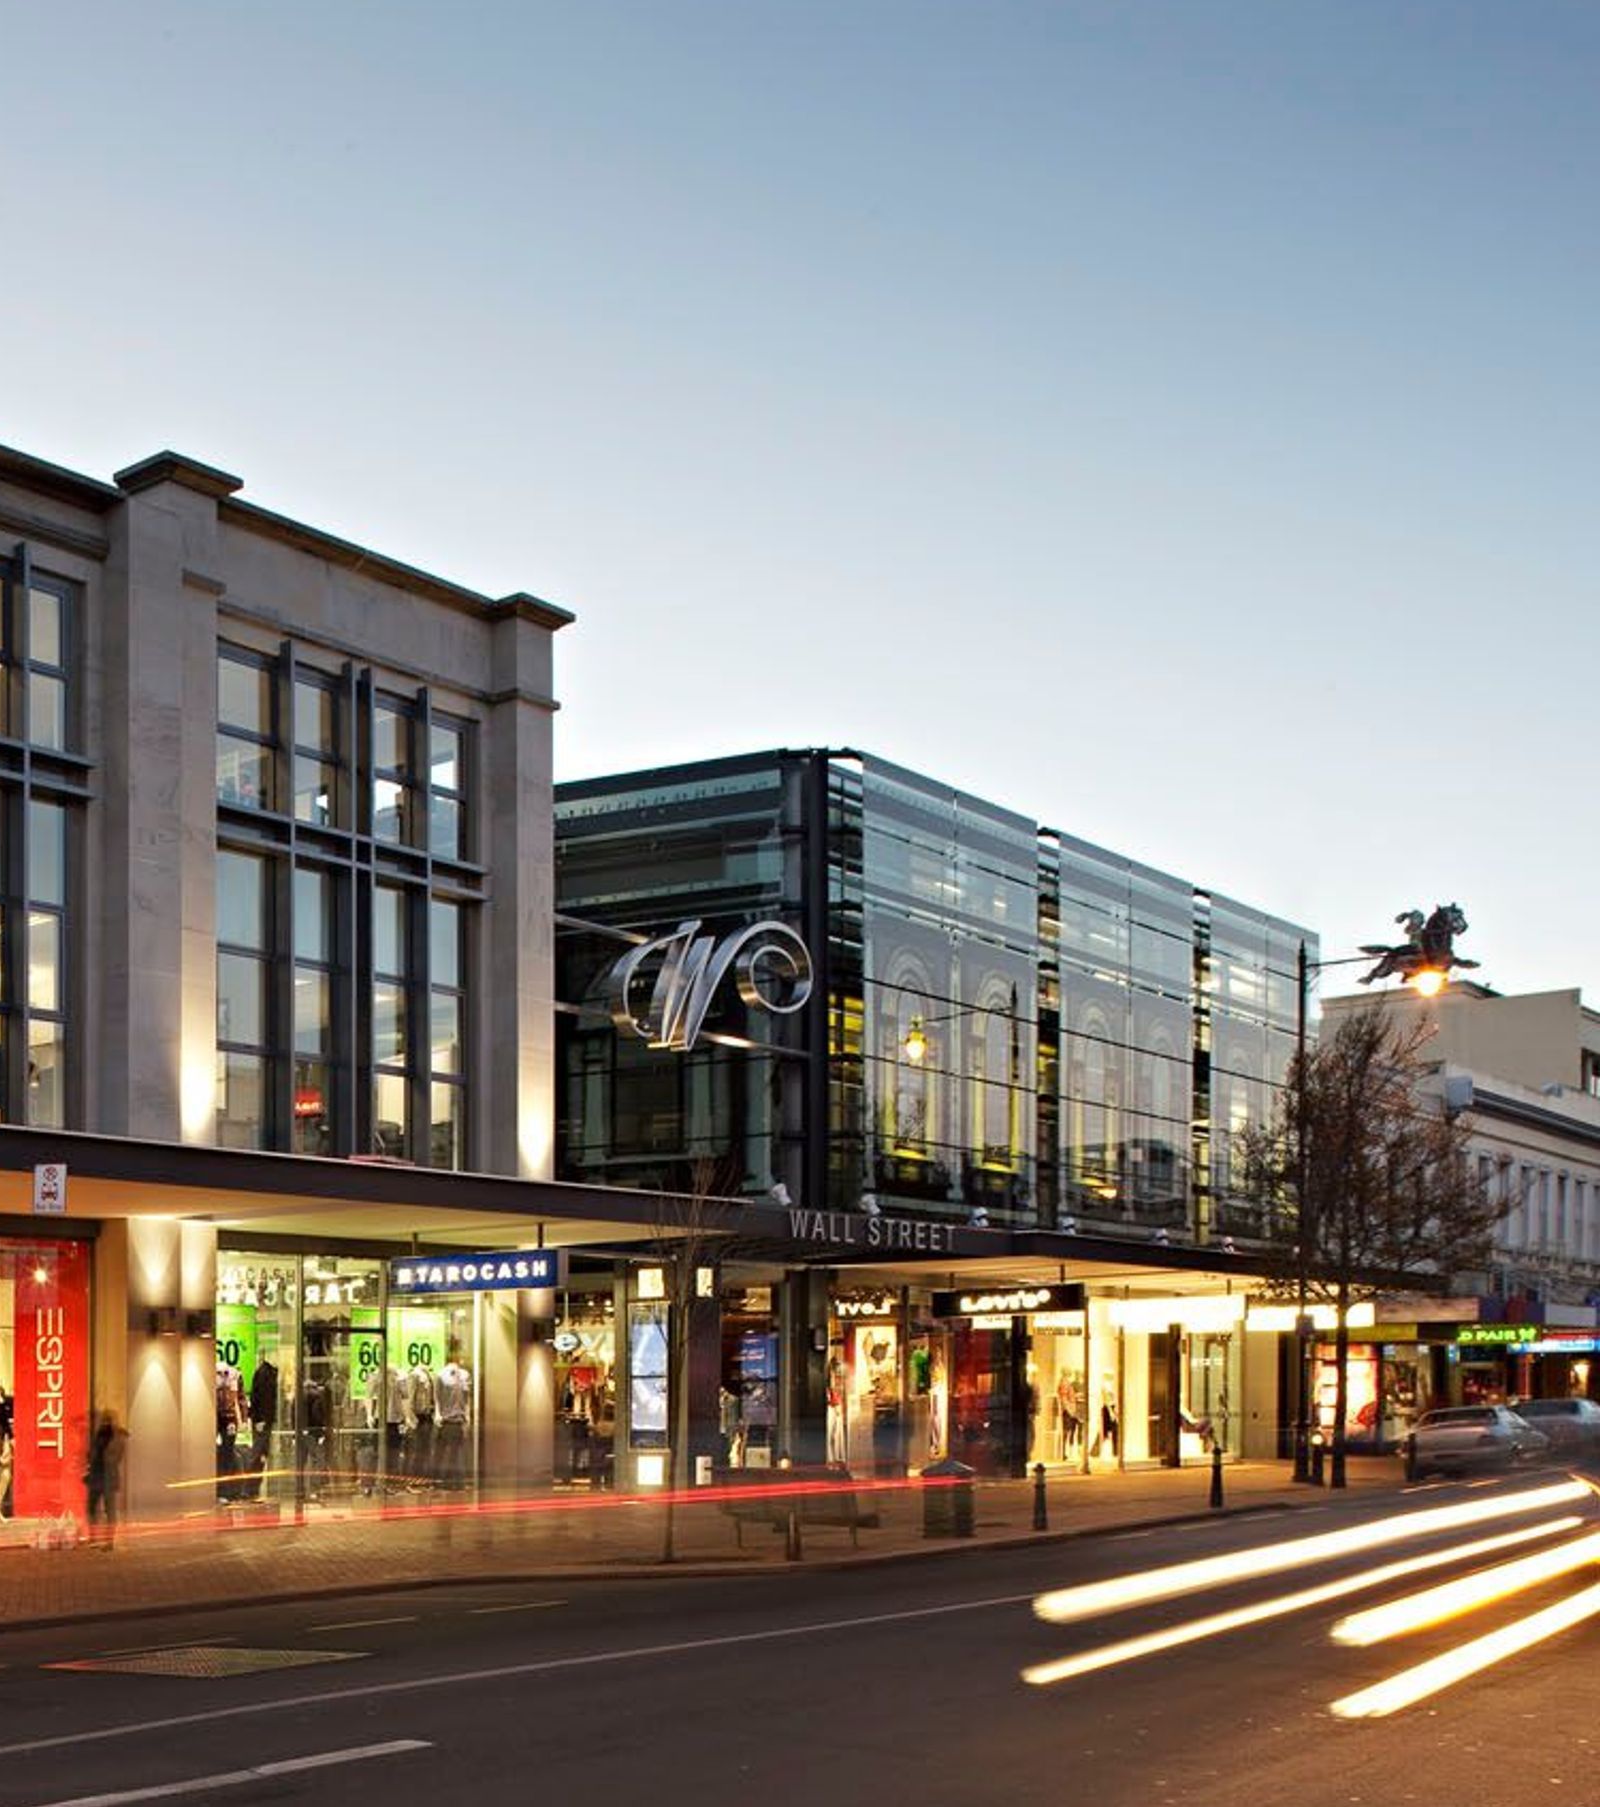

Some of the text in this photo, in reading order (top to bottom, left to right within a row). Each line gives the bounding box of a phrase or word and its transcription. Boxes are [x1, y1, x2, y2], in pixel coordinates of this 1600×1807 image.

[789, 1208, 956, 1250] WALL STREET
[415, 1261, 547, 1284] TAROCASH
[37, 1307, 64, 1458] ESPRIT
